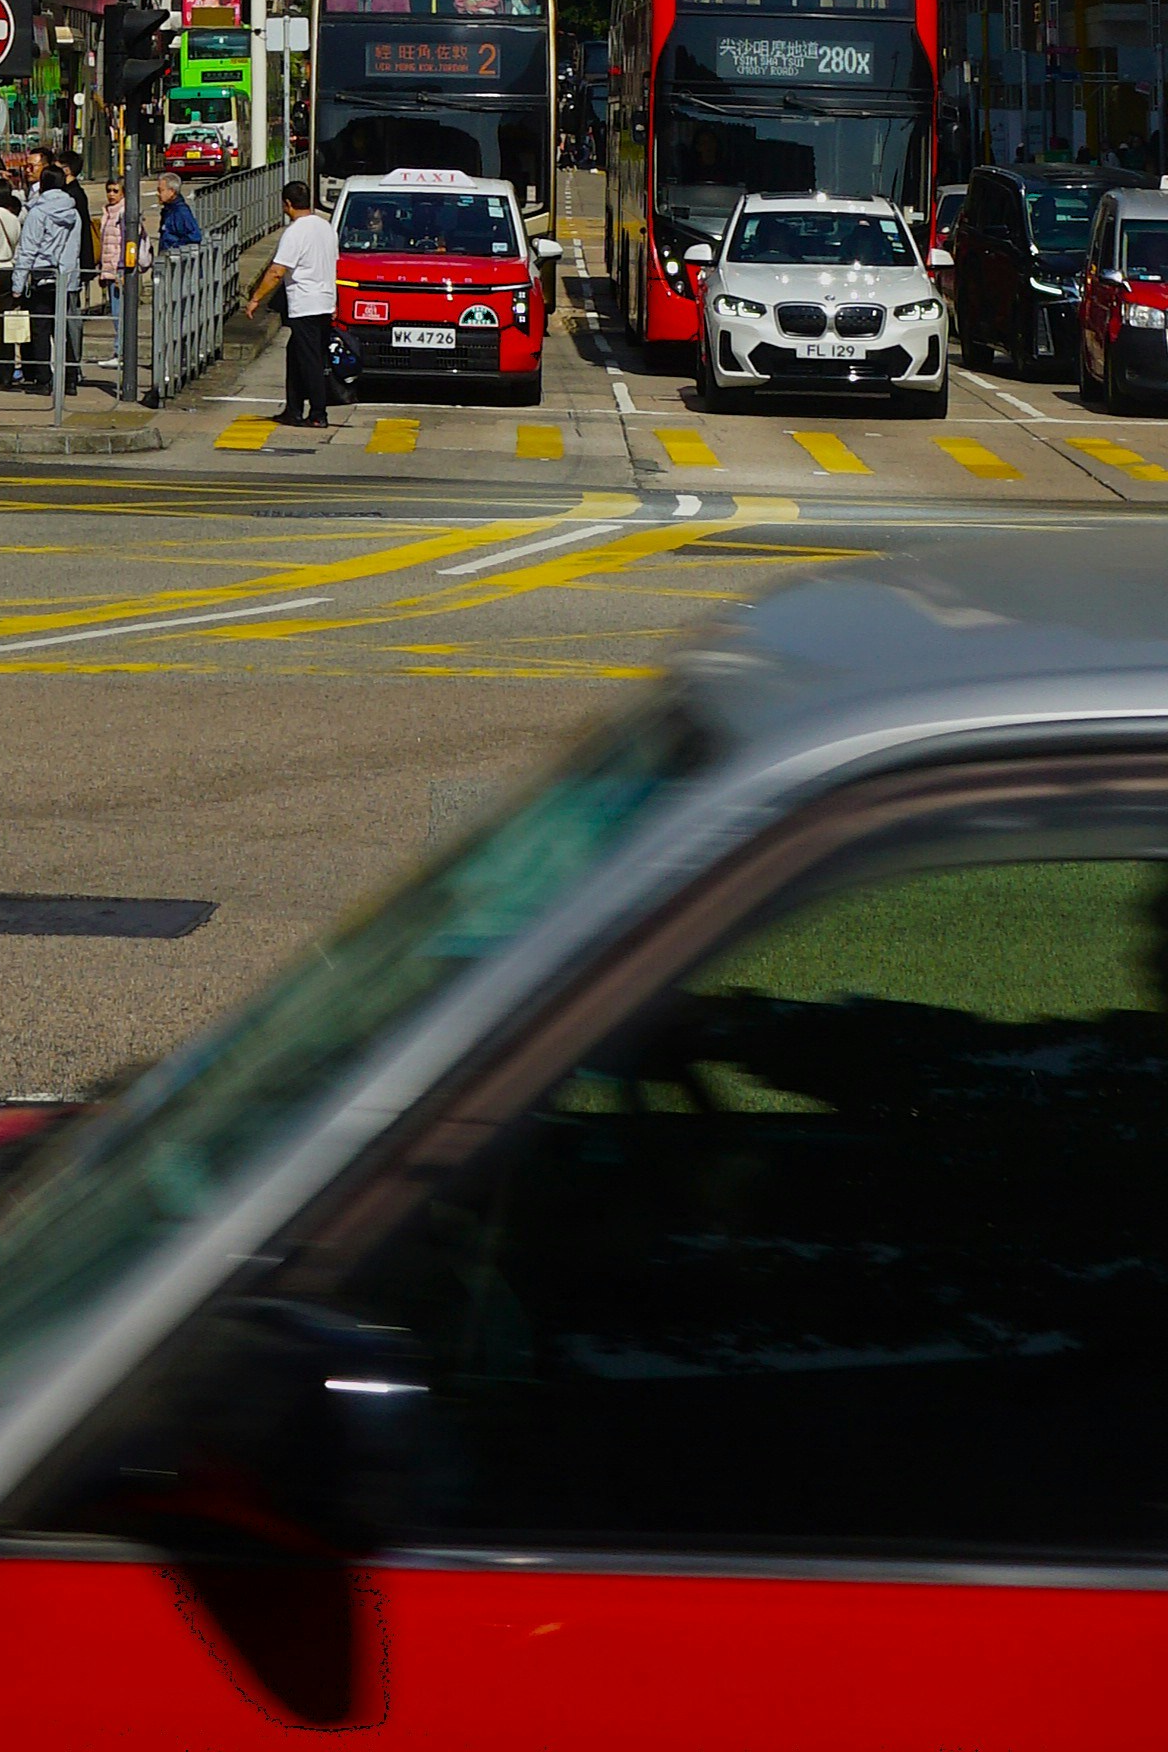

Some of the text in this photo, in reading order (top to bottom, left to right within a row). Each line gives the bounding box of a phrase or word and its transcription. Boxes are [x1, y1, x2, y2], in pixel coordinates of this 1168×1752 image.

[477, 43, 497, 75] 2
[732, 55, 805, 68] TSIM SHA TSUI
[400, 172, 455, 183] TAXI
[394, 331, 454, 344] WK 4726
[807, 344, 855, 357] FL 129
